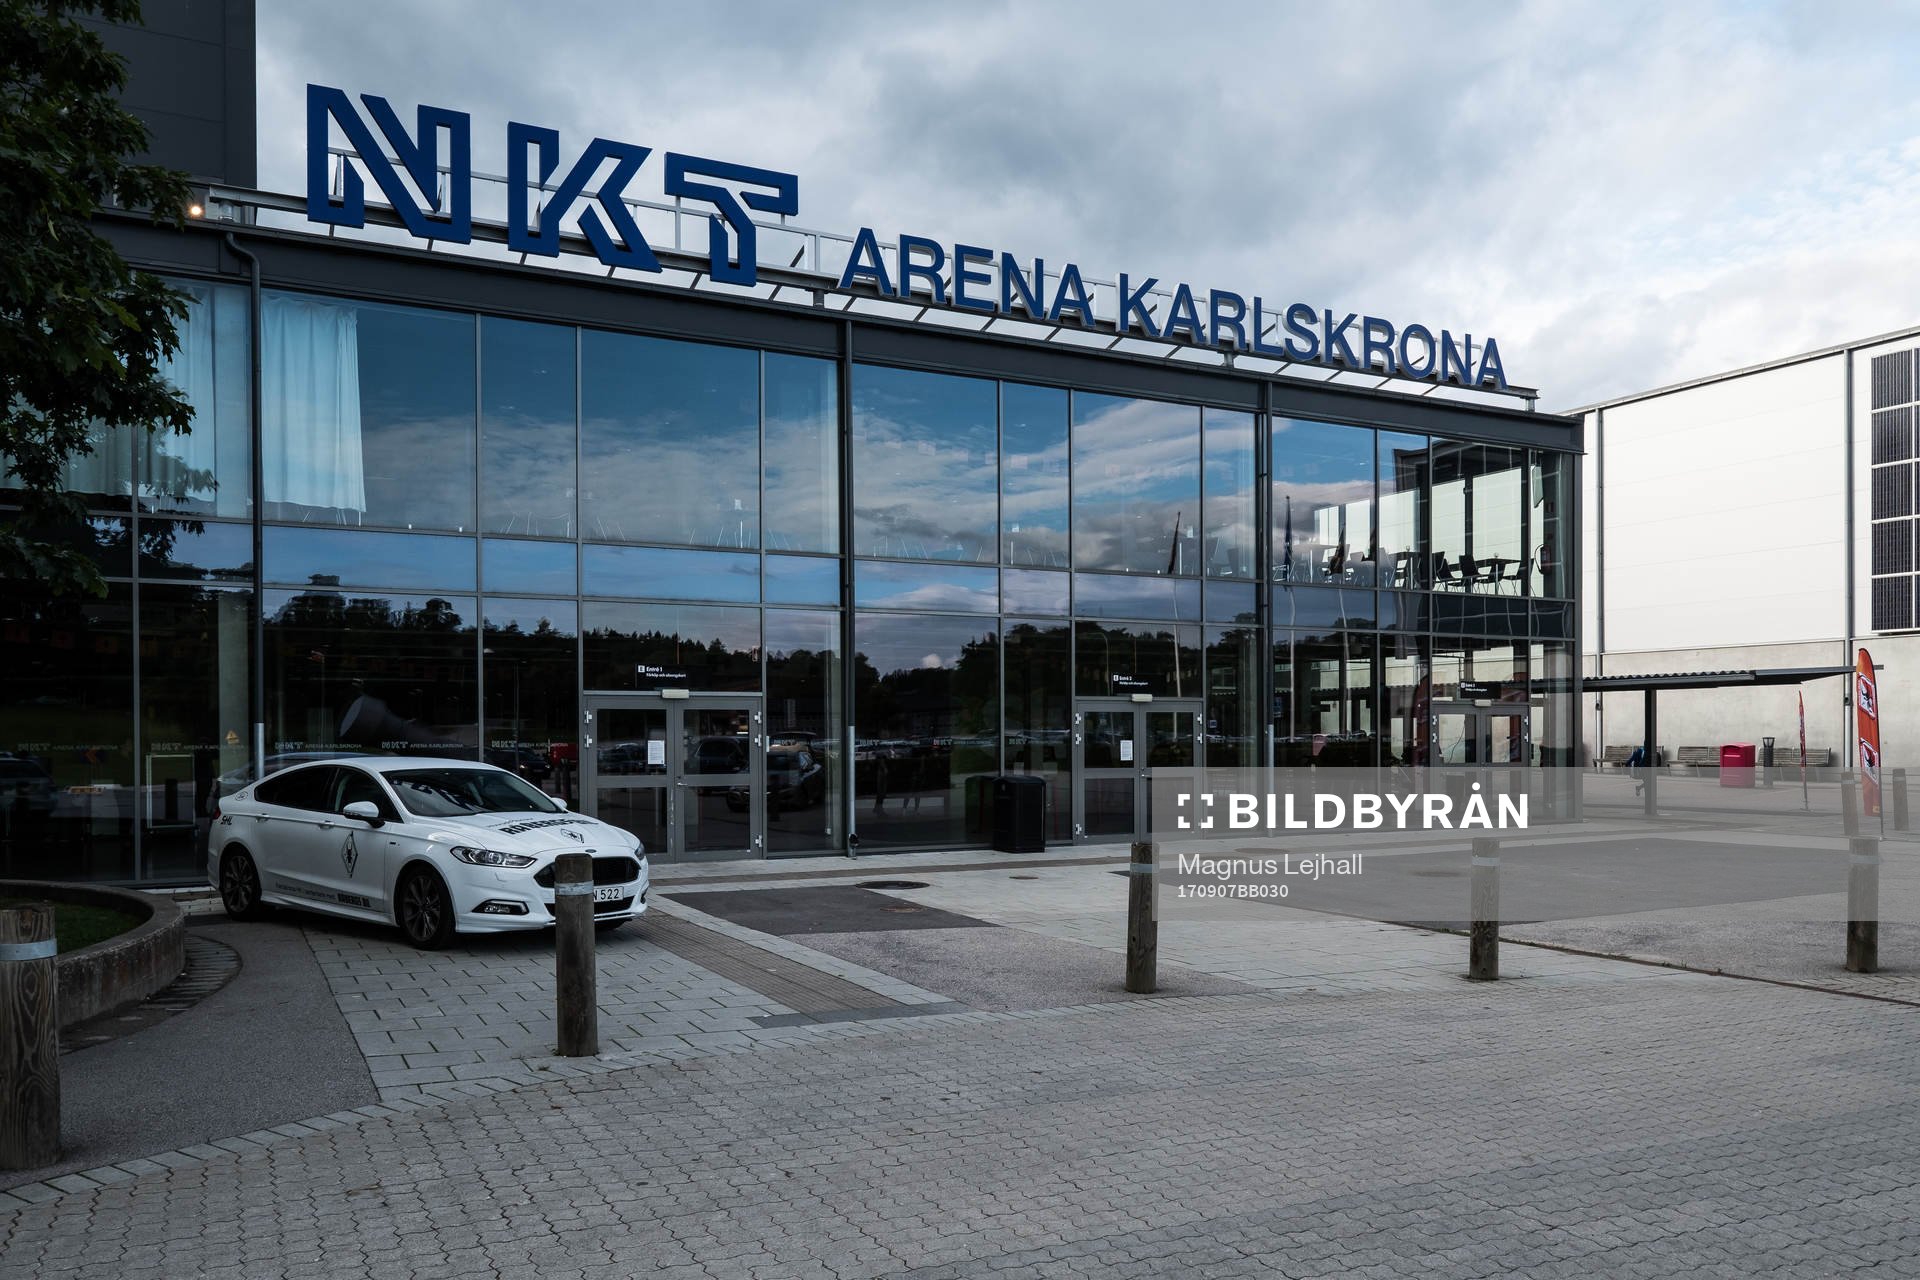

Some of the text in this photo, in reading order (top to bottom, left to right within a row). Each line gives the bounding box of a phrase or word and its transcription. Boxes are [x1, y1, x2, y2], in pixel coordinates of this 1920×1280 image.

[307, 84, 1508, 390] NKT ARENA KARLSKRONA
[601, 888, 619, 900] 522
